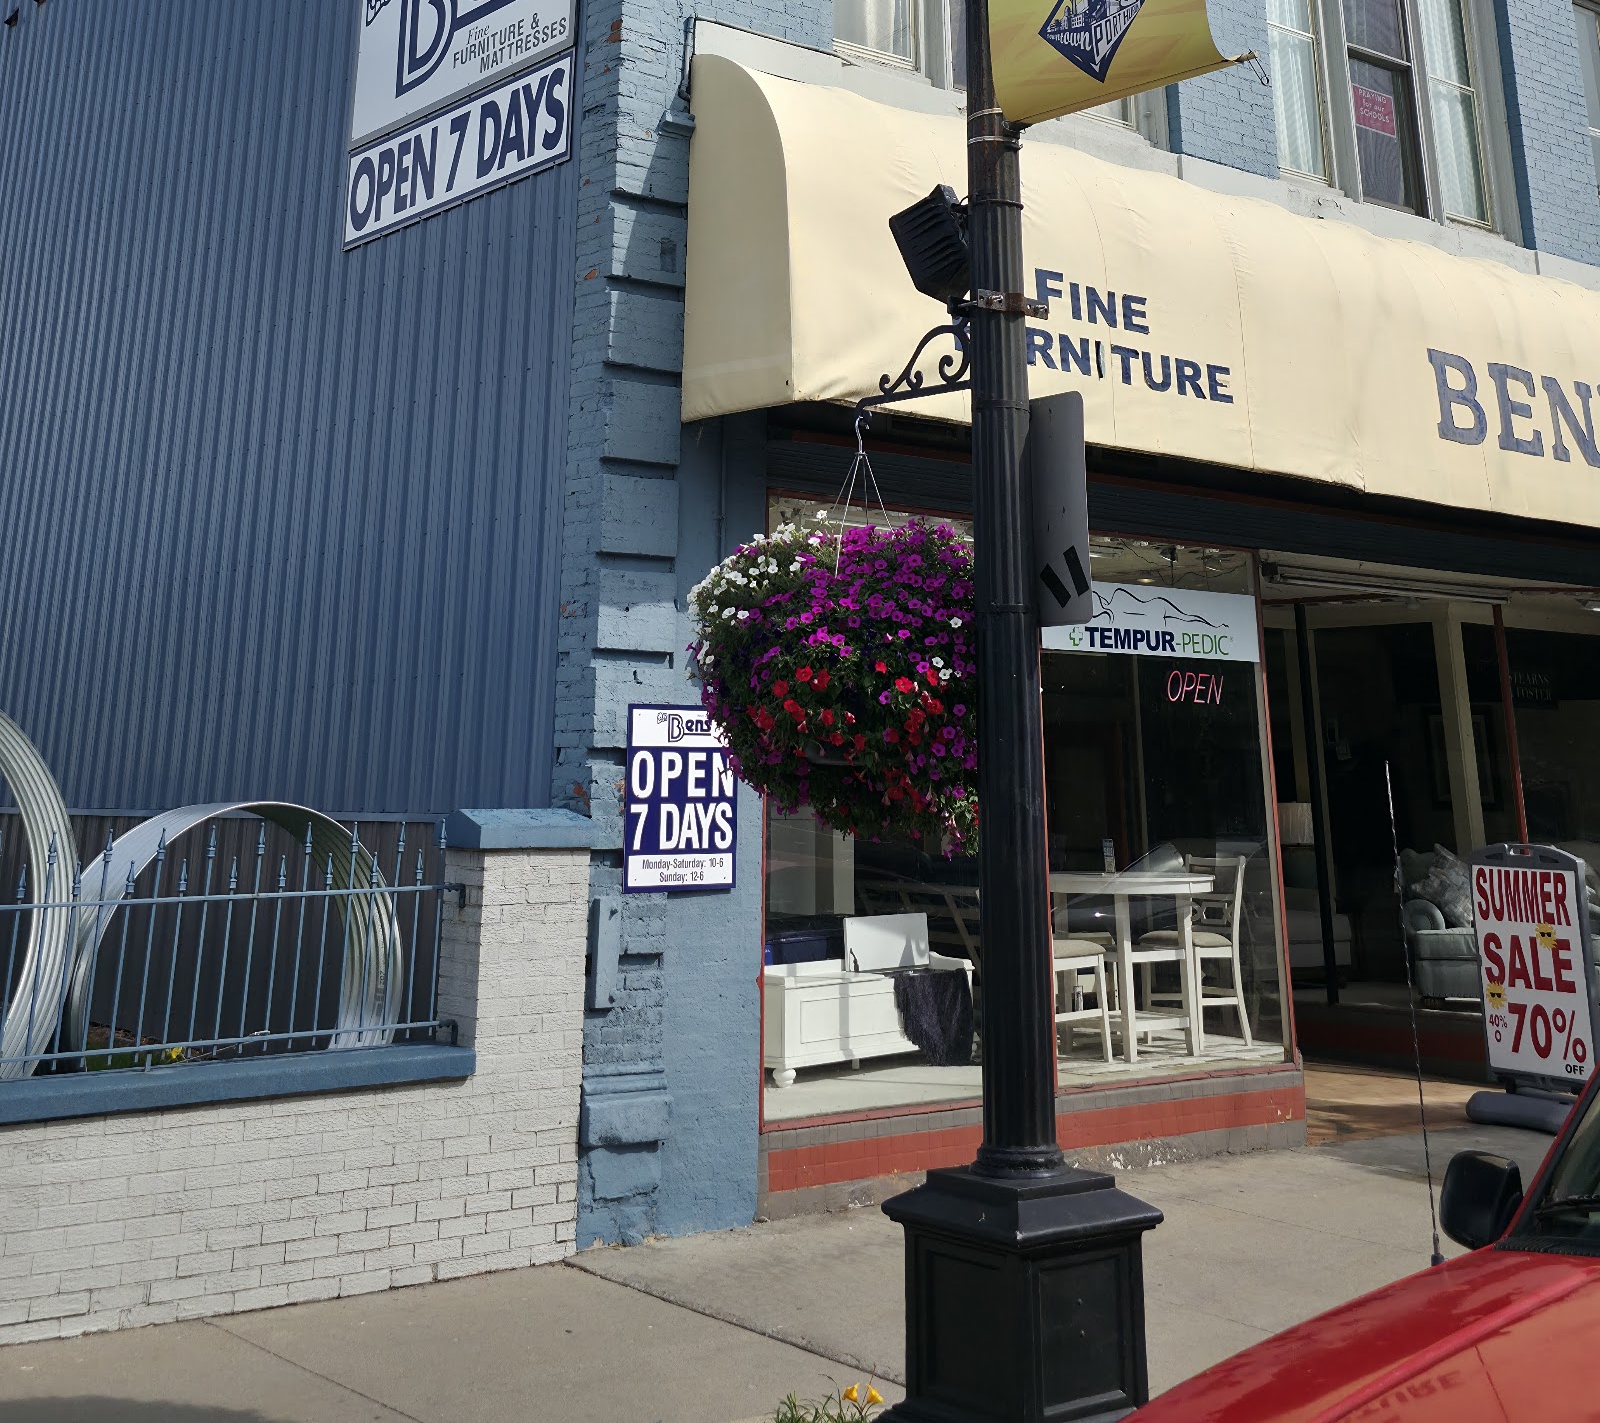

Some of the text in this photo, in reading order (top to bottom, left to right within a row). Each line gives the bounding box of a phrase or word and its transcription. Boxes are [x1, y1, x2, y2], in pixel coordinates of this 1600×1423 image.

[452, 12, 540, 70] FURNITURE &
[466, 25, 490, 46] Fine
[479, 16, 567, 74] MATTRESSES
[1093, 12, 1122, 58] PORT
[1358, 88, 1387, 104] PRAYING
[1359, 107, 1390, 123] SCHOOLS
[349, 67, 567, 232] OPEN 7 DAYS
[1035, 268, 1151, 336] FINE
[1026, 326, 1234, 404] RNITURE
[1426, 347, 1600, 469] BEN
[1085, 626, 1230, 656] TEMPUR-PEDIC
[1167, 670, 1225, 705] OPEN
[631, 750, 734, 799] OPEN
[630, 802, 733, 851] 7 DAYS
[642, 857, 724, 871] Monday-Saturday: 10-6
[659, 870, 704, 883] Sunday: 12-6
[1475, 867, 1572, 926] SUMMER
[1483, 932, 1577, 994] SALE
[1489, 1013, 1508, 1028] 40%
[1507, 1002, 1587, 1064] 70%
[1565, 1063, 1585, 1075] OFF
